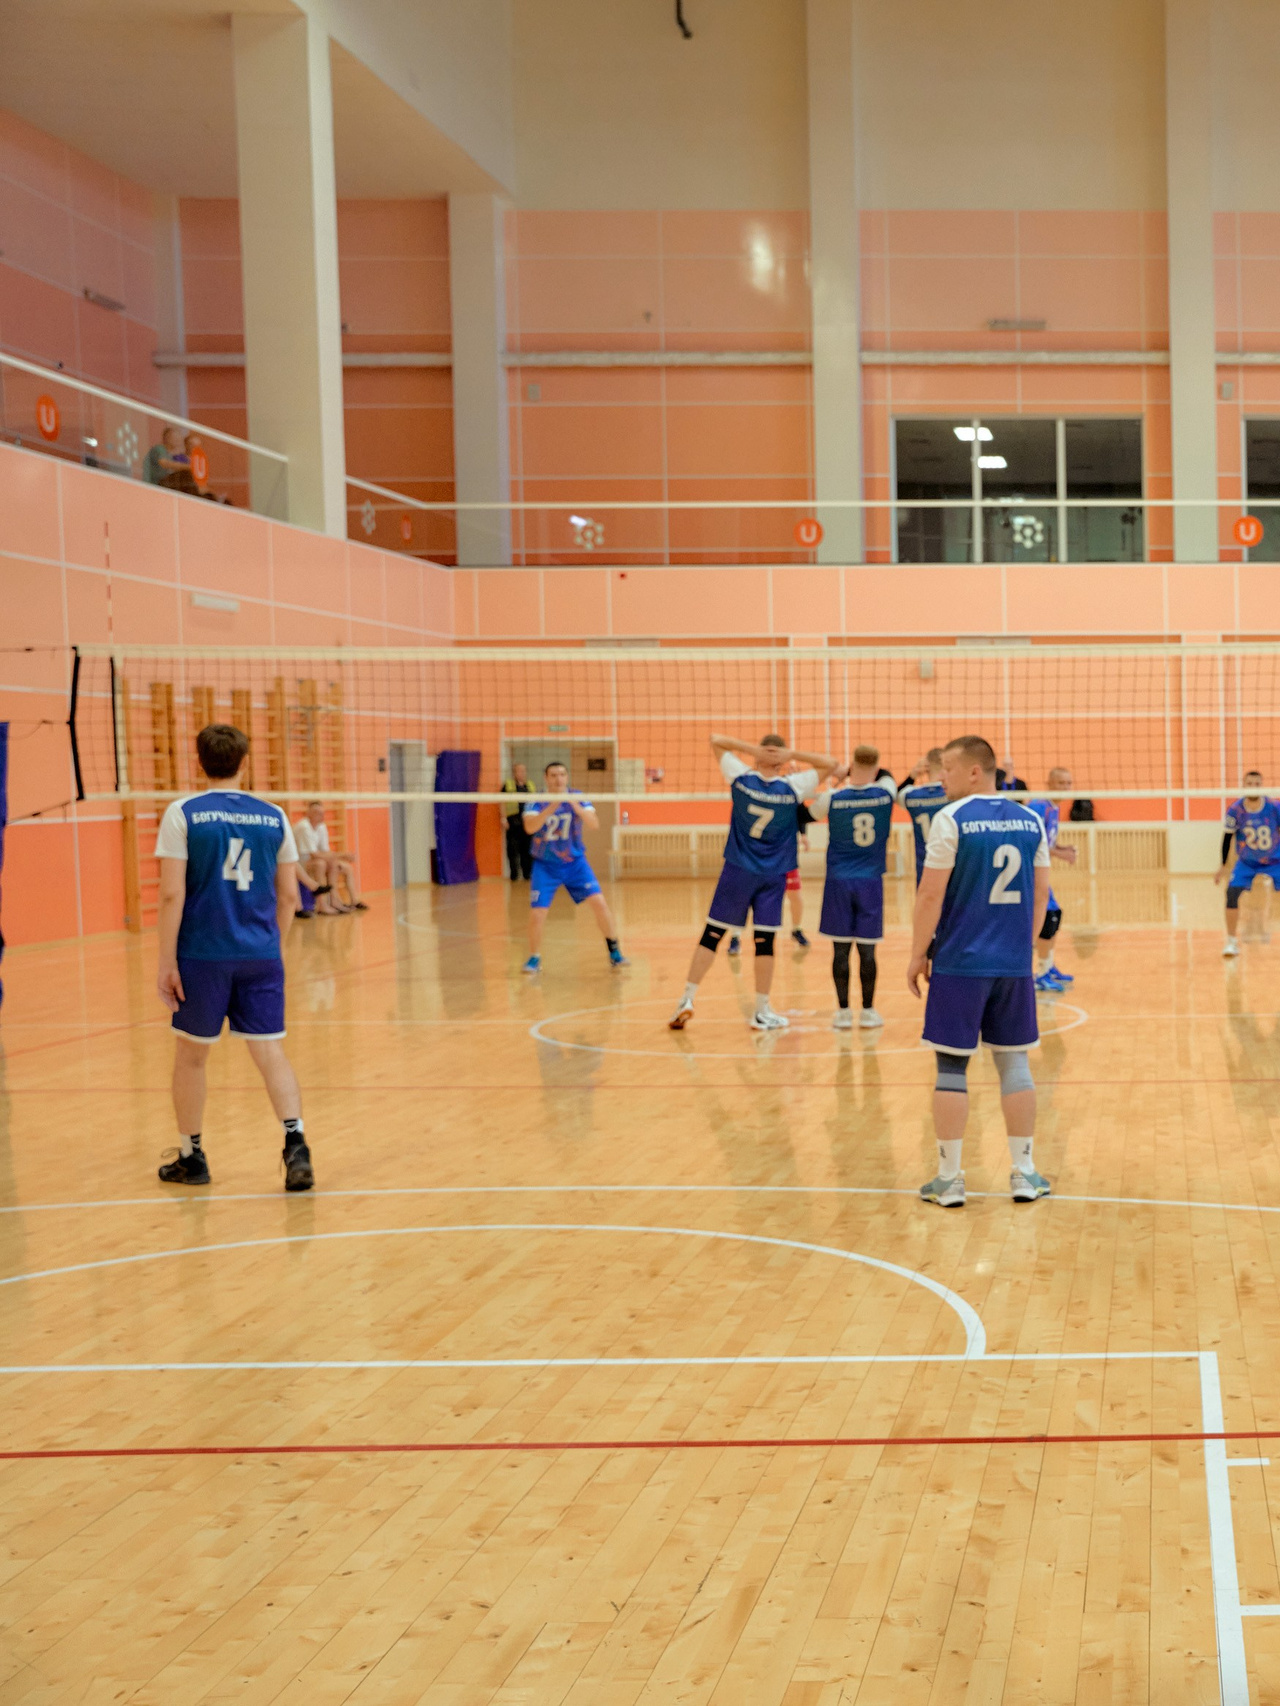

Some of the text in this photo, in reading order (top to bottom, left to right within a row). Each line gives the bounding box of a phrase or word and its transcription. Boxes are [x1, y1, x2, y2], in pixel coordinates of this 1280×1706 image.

[40, 404, 56, 433] U
[801, 525, 817, 543] U
[1239, 522, 1256, 541] U
[546, 812, 573, 841] 27
[747, 803, 775, 839] 7
[852, 812, 876, 848] 8
[1242, 825, 1272, 851] 28
[223, 837, 254, 891] 4
[989, 844, 1022, 904] 2
